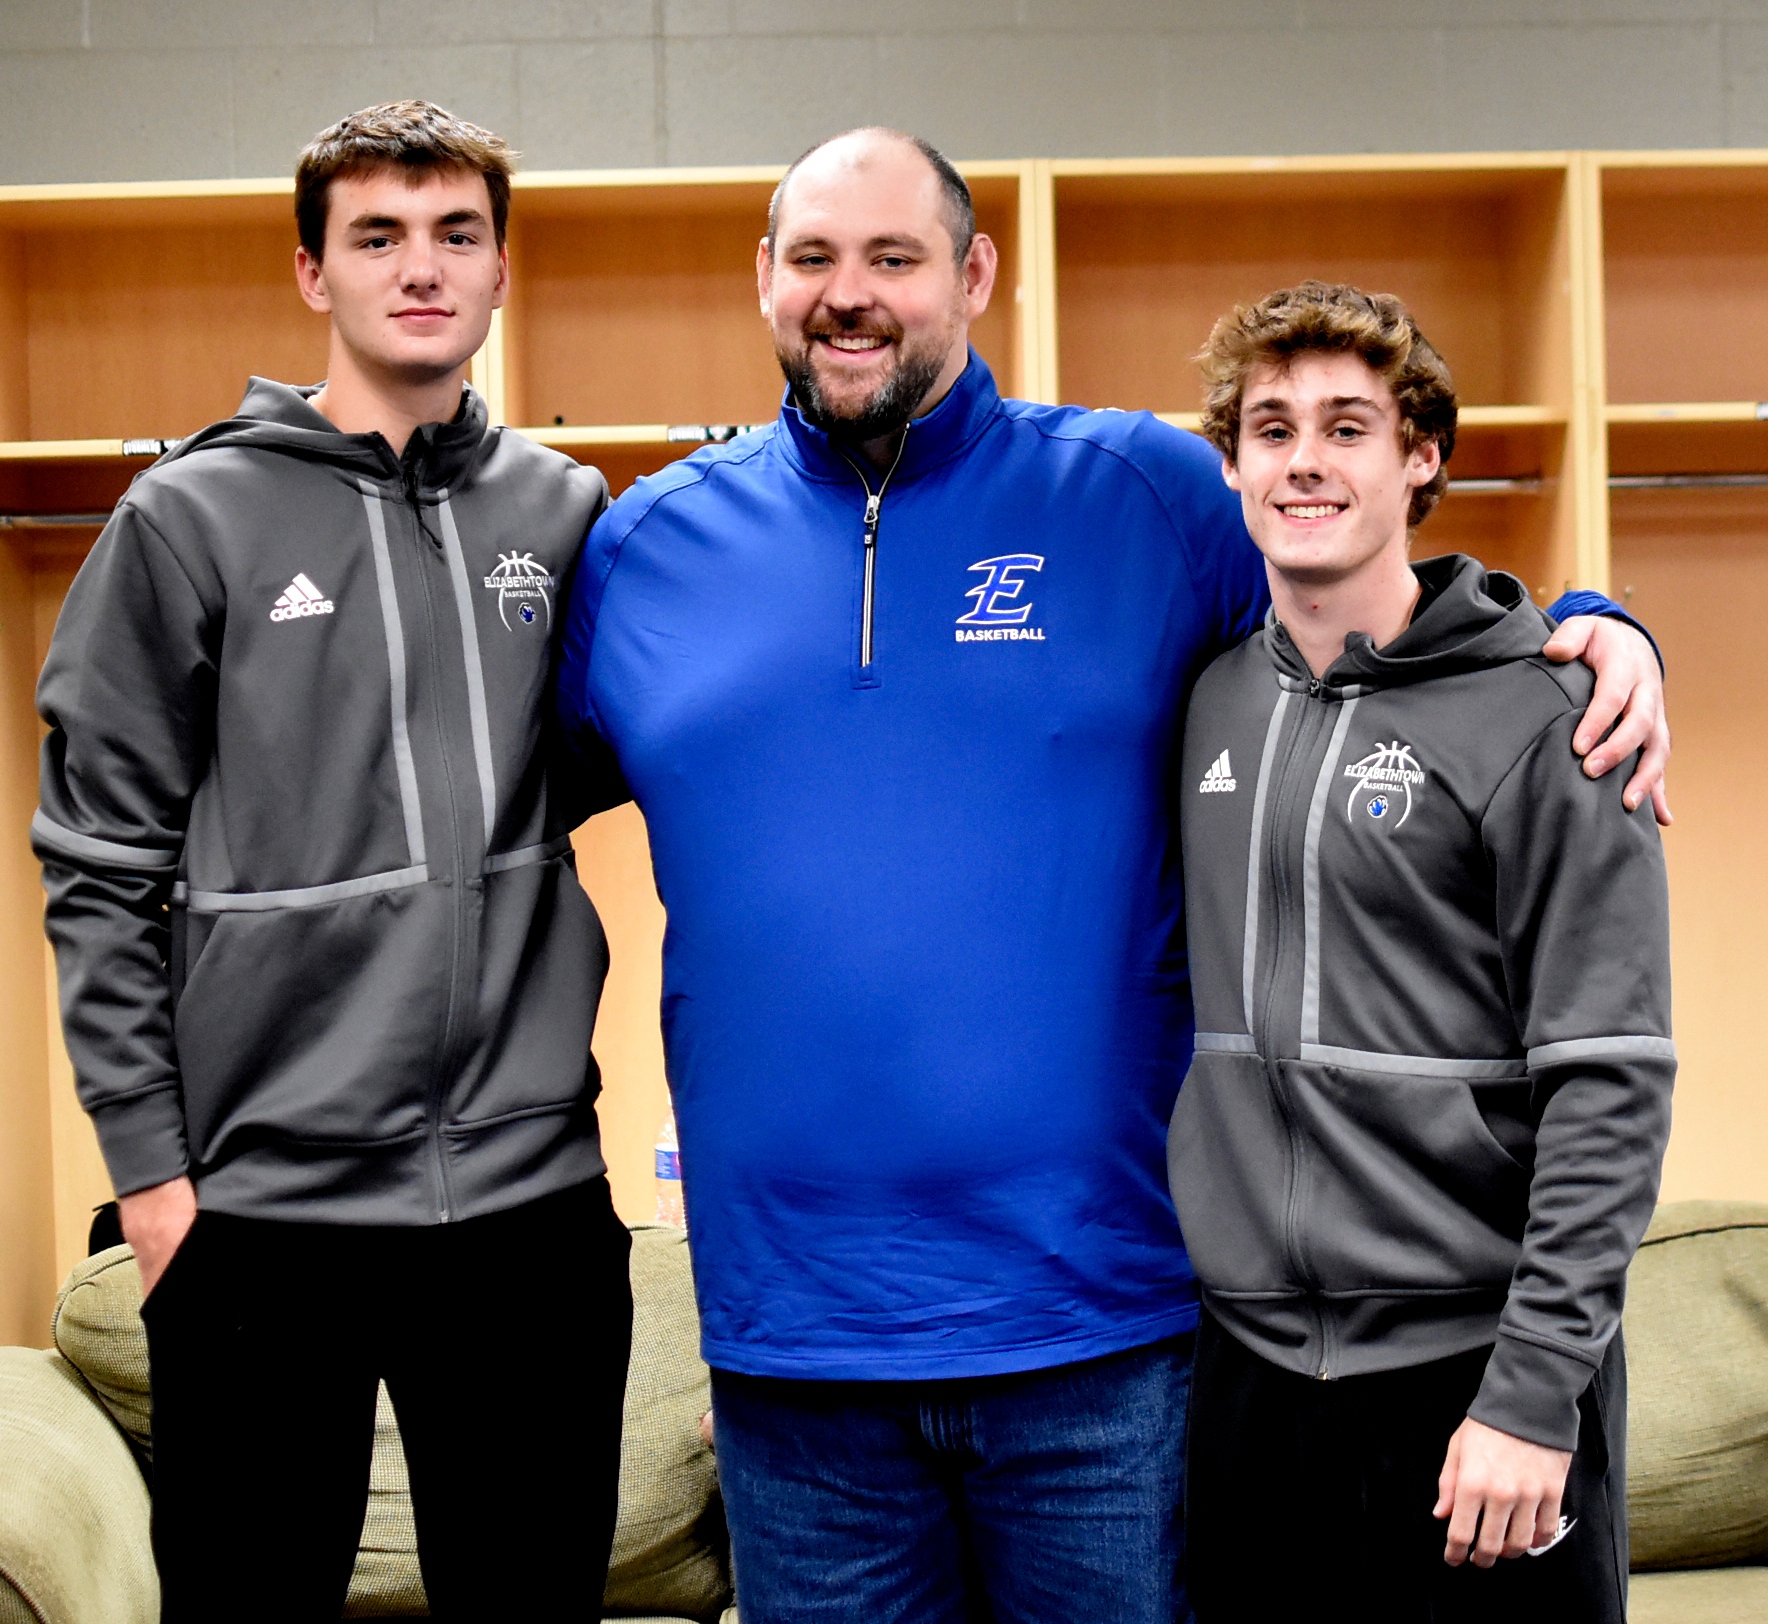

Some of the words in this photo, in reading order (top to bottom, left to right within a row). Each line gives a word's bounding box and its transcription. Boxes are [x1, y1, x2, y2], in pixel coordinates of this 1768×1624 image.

[483, 575, 555, 588] ELIZABETHTOWN
[955, 553, 1045, 624] E
[269, 599, 334, 622] adidas
[955, 627, 1045, 642] BASKETBALL
[1343, 764, 1426, 784] ELIZABETHTOWN
[1199, 777, 1237, 793] adidas
[1363, 782, 1404, 792] BASKETBALL
